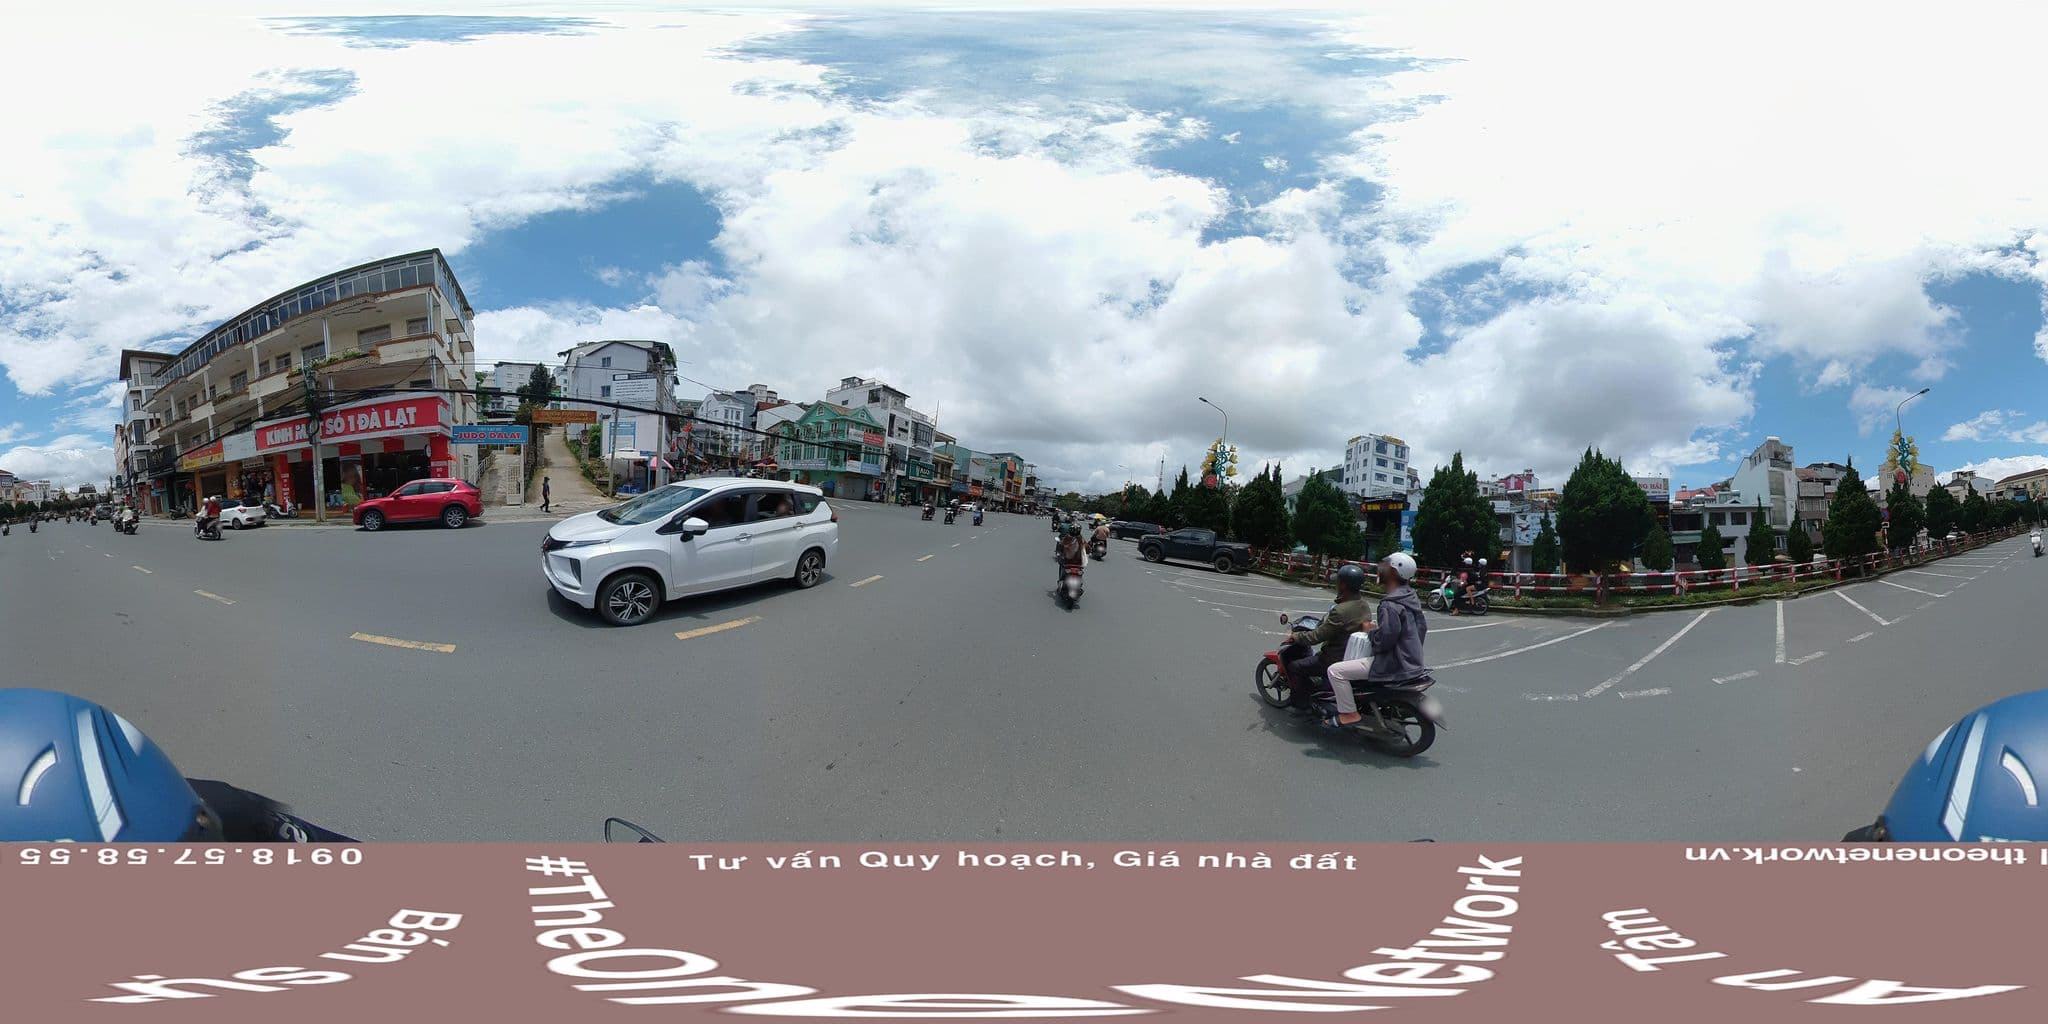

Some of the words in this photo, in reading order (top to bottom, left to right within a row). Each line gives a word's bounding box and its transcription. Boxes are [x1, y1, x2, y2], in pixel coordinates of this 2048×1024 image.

[326, 410, 346, 435] SỐ
[357, 408, 382, 432] ĐÀ
[384, 406, 417, 429] LẠT
